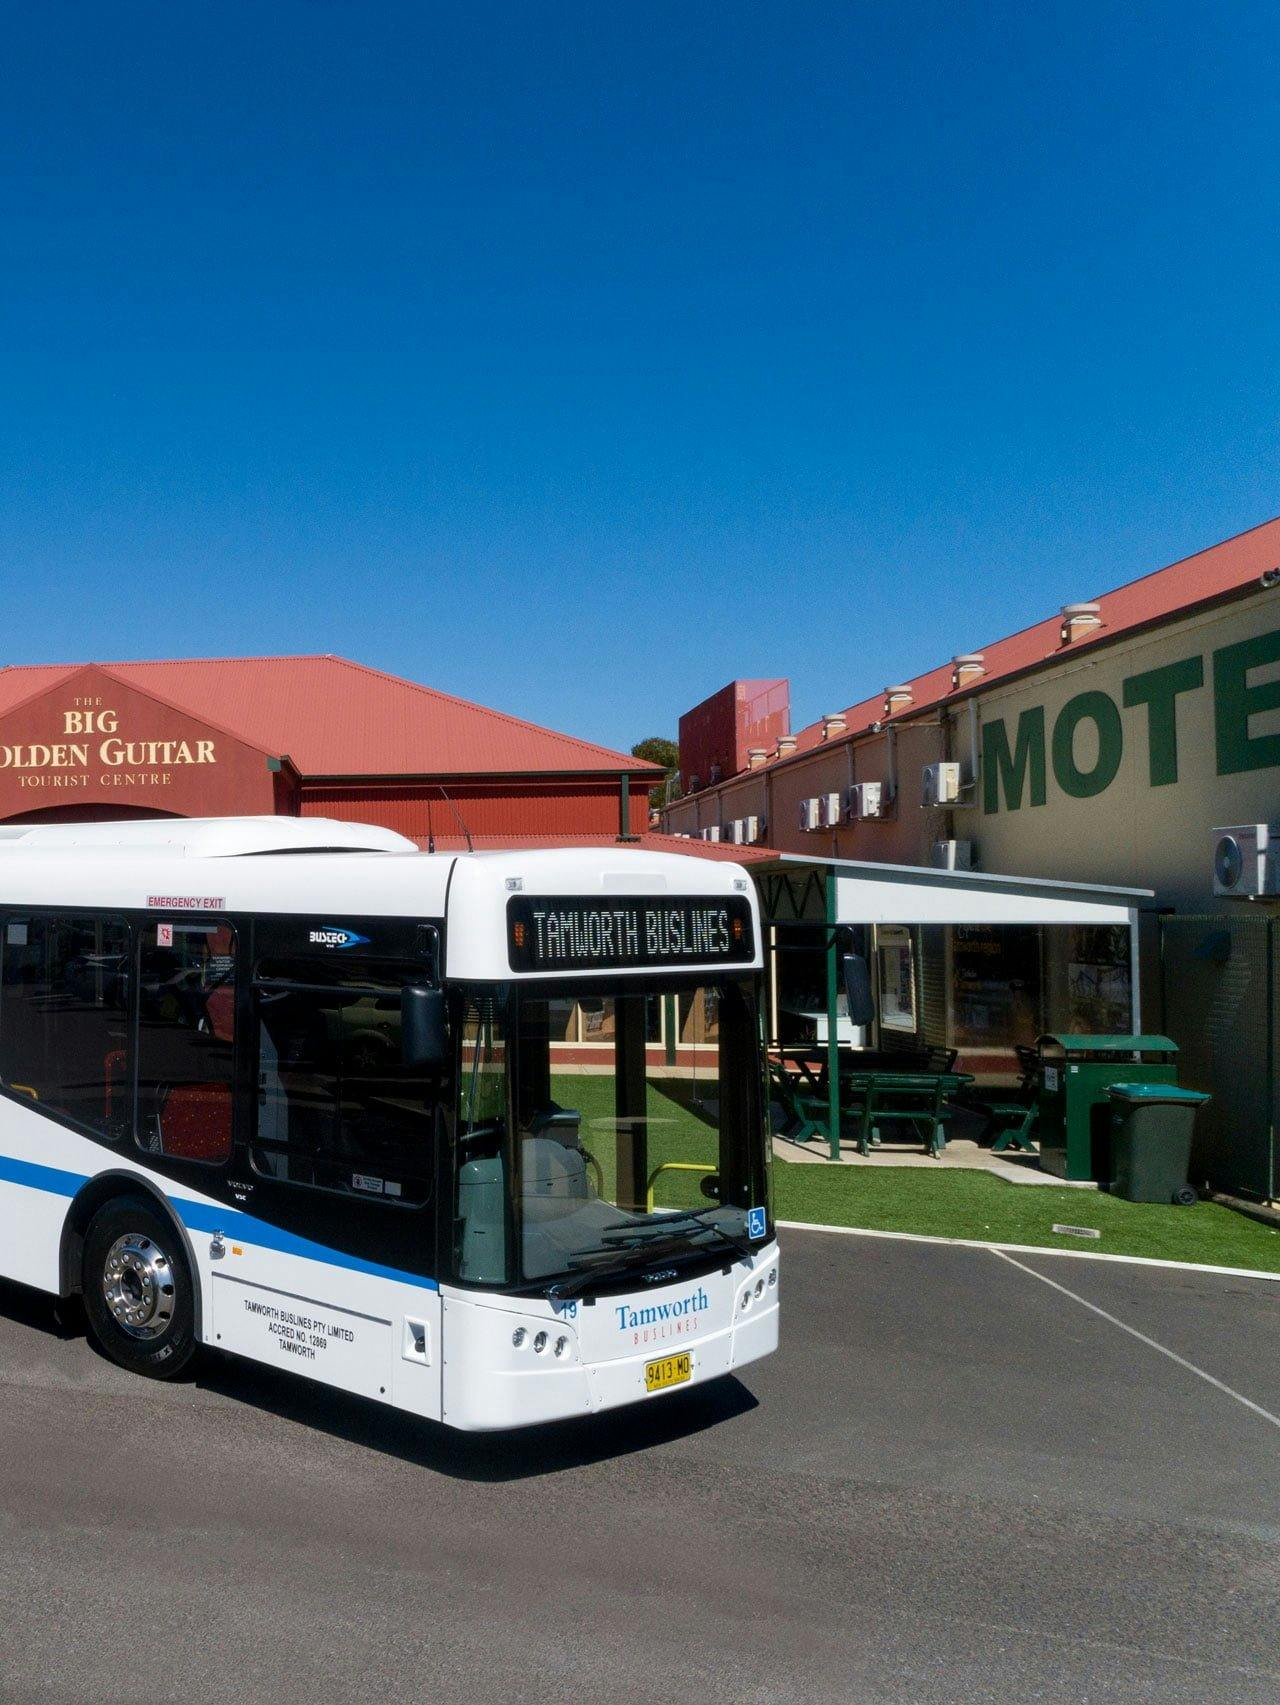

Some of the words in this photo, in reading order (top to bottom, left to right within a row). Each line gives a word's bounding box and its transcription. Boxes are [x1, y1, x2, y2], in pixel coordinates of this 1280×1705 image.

[74, 698, 102, 706] THE
[64, 710, 119, 734] BIG
[99, 739, 216, 765] GUITAR
[18, 775, 90, 787] TOURIST
[100, 773, 171, 786] CENTRE
[148, 896, 201, 908] EMERGENCY
[203, 898, 224, 909] EXIT
[533, 911, 639, 958] TAMWORTH
[646, 910, 730, 954] BUSLINES
[561, 1301, 577, 1319] 19
[615, 1286, 708, 1330] Tamworth
[244, 1300, 279, 1319] TAMWORTH
[280, 1311, 312, 1330] BUSLINES
[313, 1320, 326, 1334] PTY
[327, 1325, 354, 1342] LIMITED
[268, 1322, 294, 1339] ACCRED
[296, 1330, 308, 1343] NO.
[633, 1318, 697, 1345] BUSLINES
[279, 1338, 316, 1360] TAMWORTH
